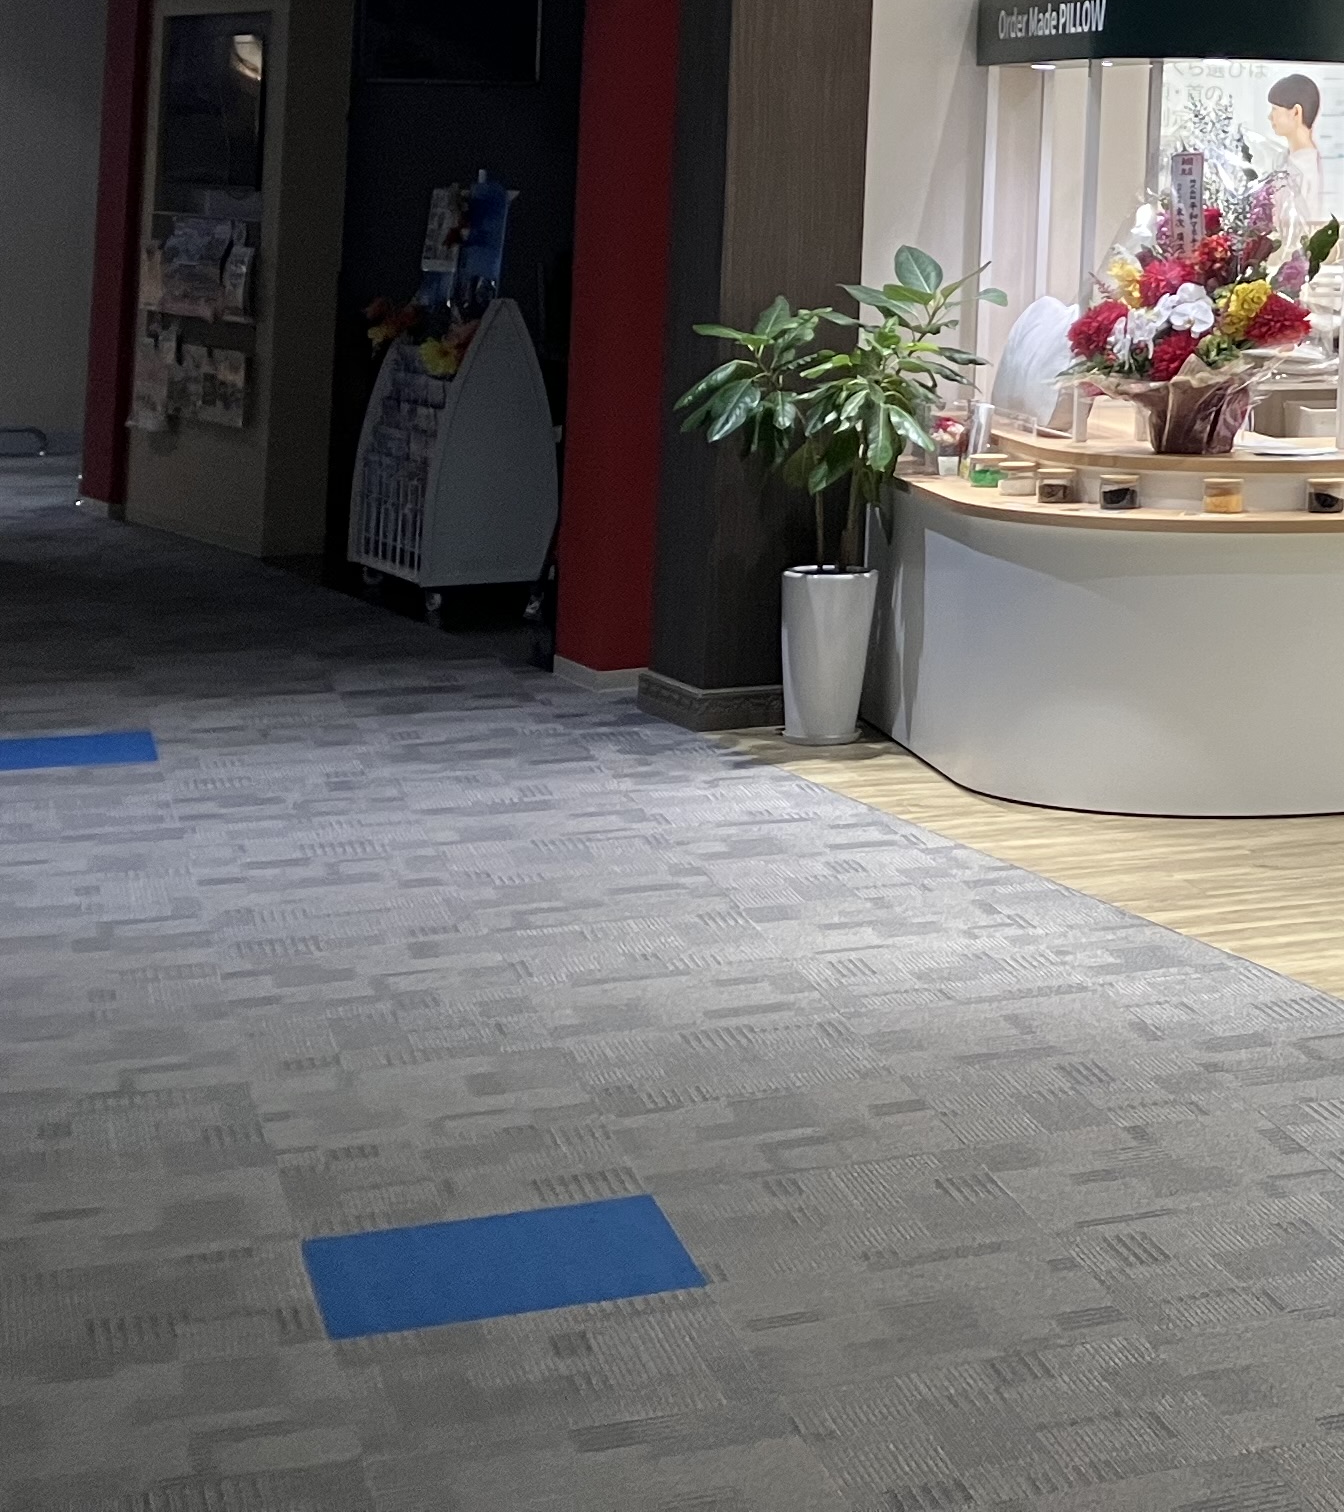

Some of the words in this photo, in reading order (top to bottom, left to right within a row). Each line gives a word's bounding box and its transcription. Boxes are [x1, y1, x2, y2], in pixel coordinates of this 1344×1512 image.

[998, 7, 1028, 40] Order
[1028, 3, 1058, 37] Made
[1058, 0, 1107, 35] PILLOW
